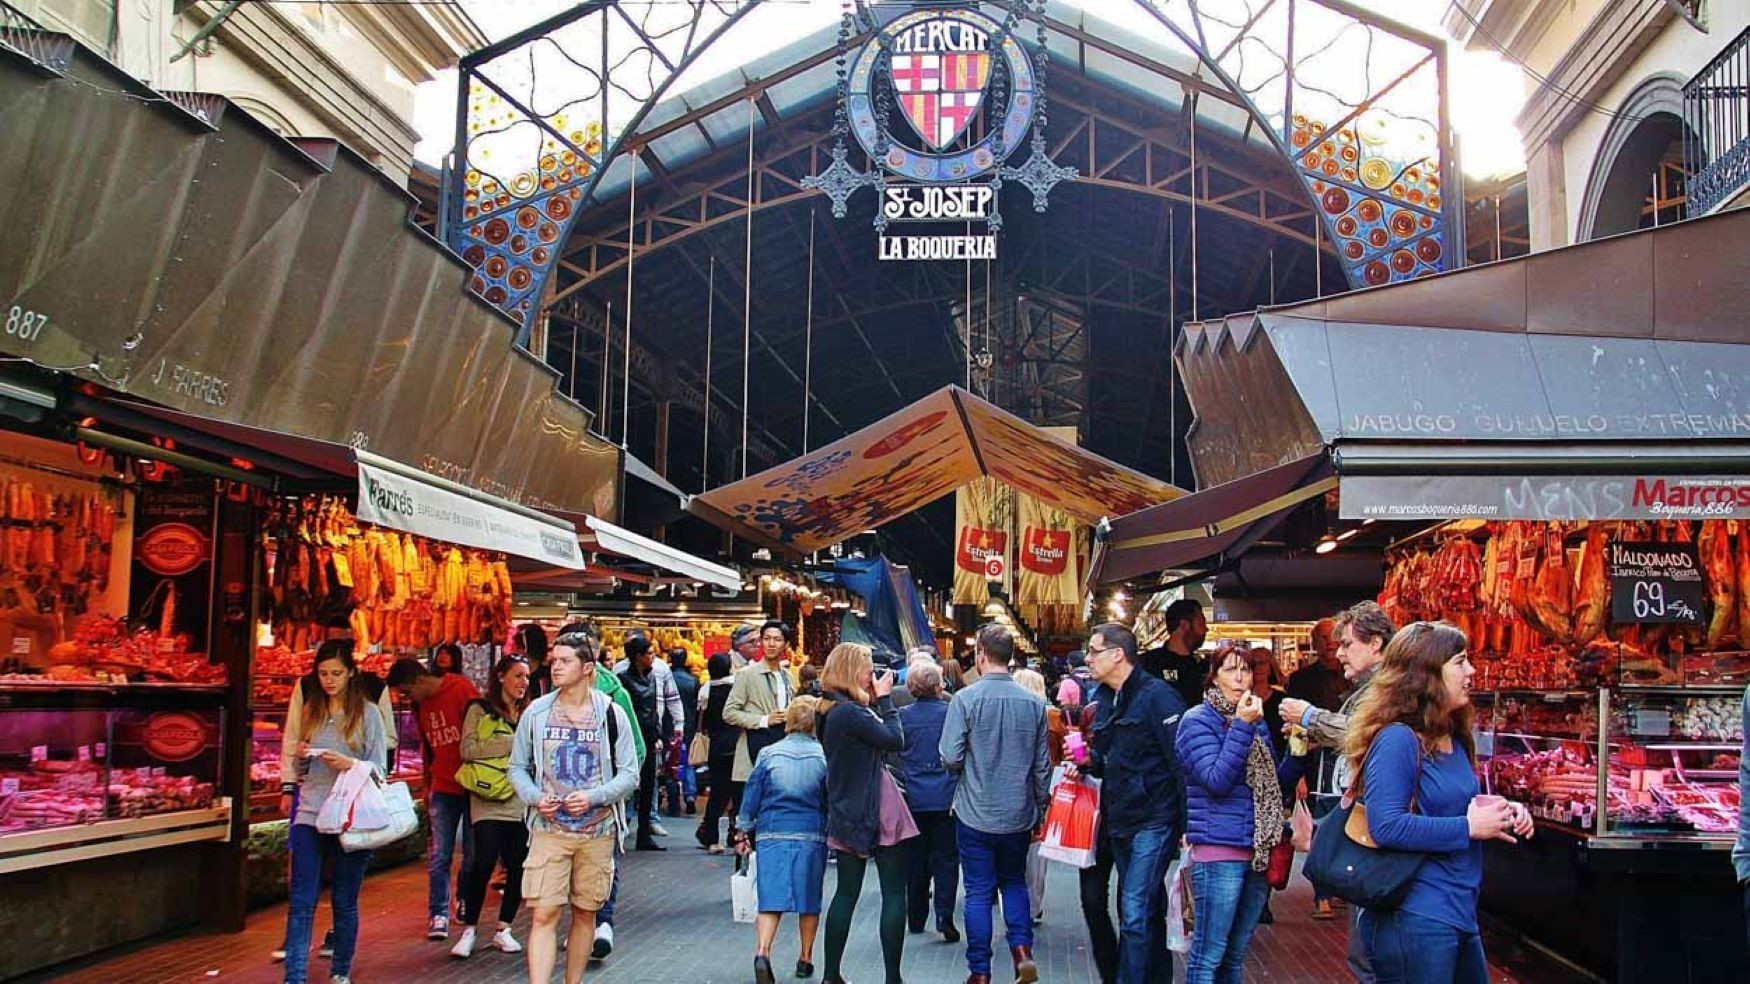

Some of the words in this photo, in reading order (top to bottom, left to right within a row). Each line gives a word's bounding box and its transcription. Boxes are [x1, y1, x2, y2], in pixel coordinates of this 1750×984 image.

[896, 20, 988, 53] MERCAT
[909, 186, 992, 218] JOSEP
[879, 235, 903, 260] LA
[906, 235, 997, 260] BOQUERIA
[5, 305, 48, 341] 887
[1348, 414, 1455, 432] JABUGO
[369, 477, 414, 516] Farrés
[1632, 477, 1750, 507] Marcos
[1030, 543, 1064, 558] Estrella
[1612, 544, 1692, 568] MALDONADO
[990, 562, 998, 574] 6
[1633, 581, 1665, 618] 69
[543, 727, 570, 740] THE
[556, 746, 594, 781] 10
